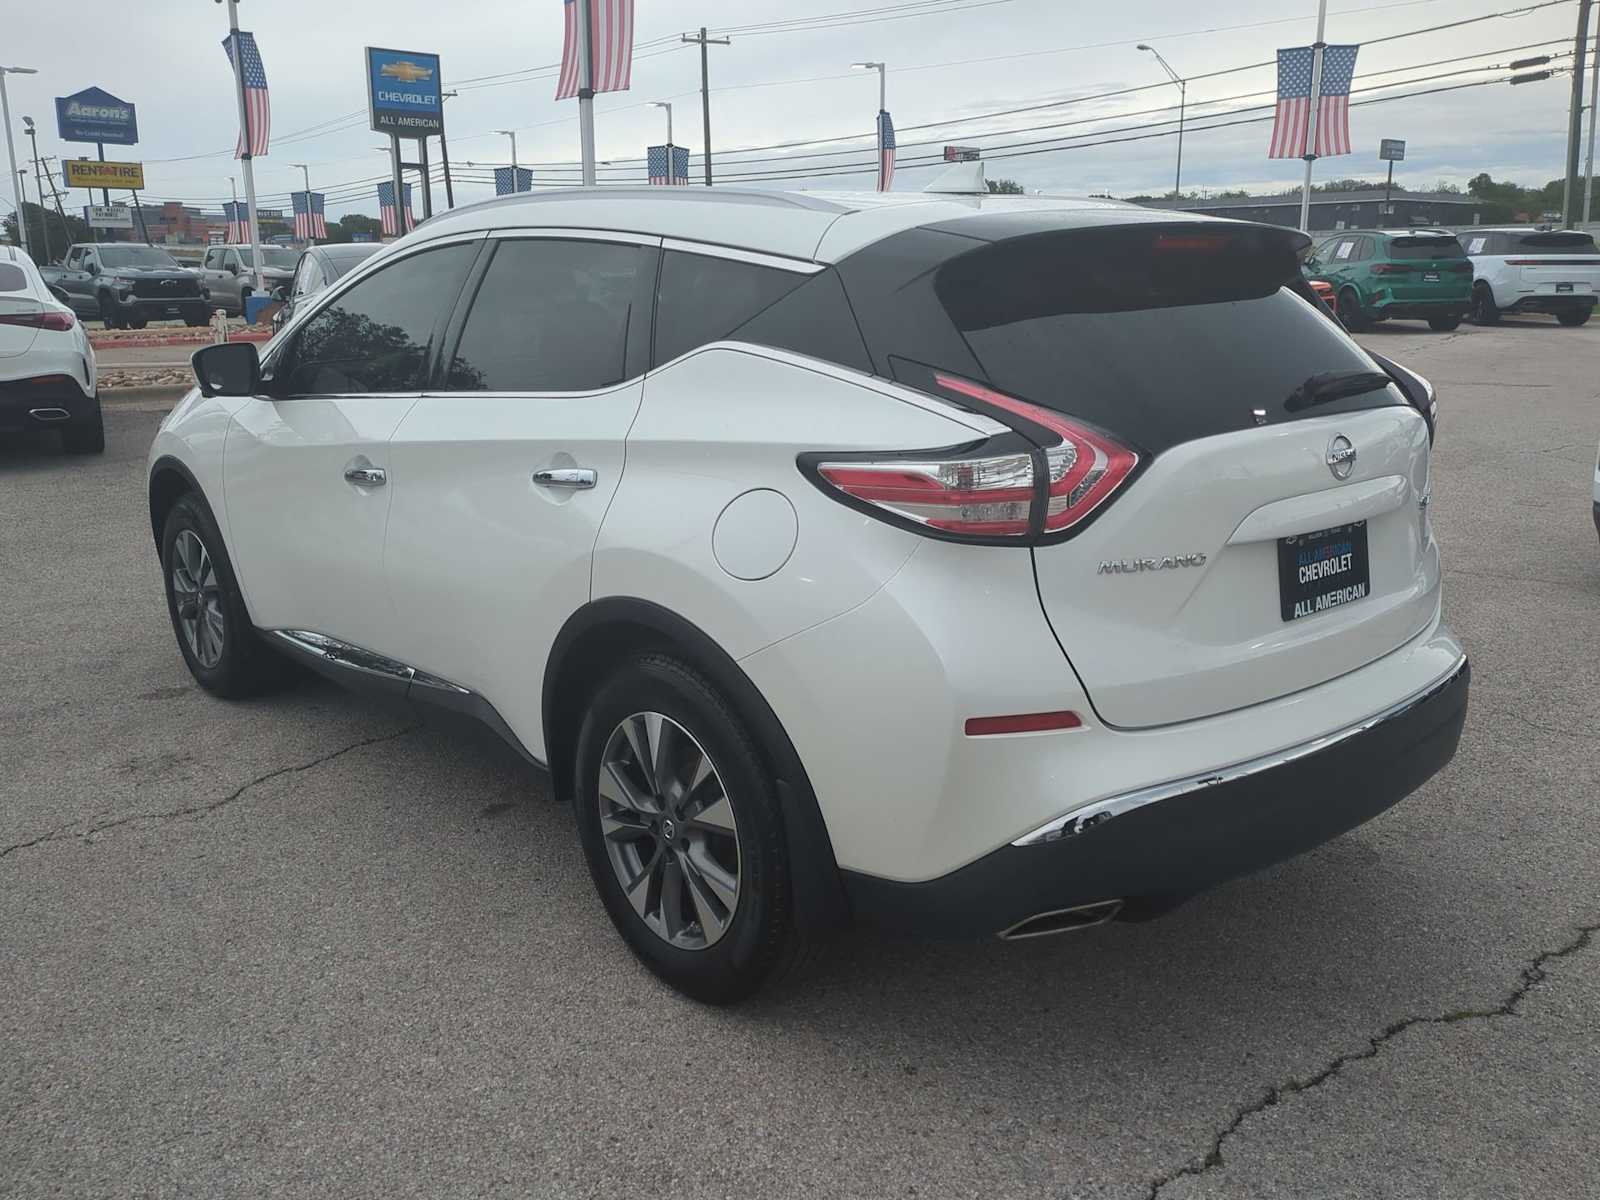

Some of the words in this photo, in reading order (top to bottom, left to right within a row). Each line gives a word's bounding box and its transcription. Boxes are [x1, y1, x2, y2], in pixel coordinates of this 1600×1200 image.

[378, 91, 437, 105] CHEVROLET
[68, 102, 129, 120] Aaron's
[380, 114, 396, 125] ALL
[398, 116, 439, 129] AMERICAN
[1097, 552, 1207, 575] MURANO
[1299, 553, 1353, 584] CHEVROLET
[1294, 600, 1314, 618] ALL
[1316, 582, 1366, 611] AMERICAN
